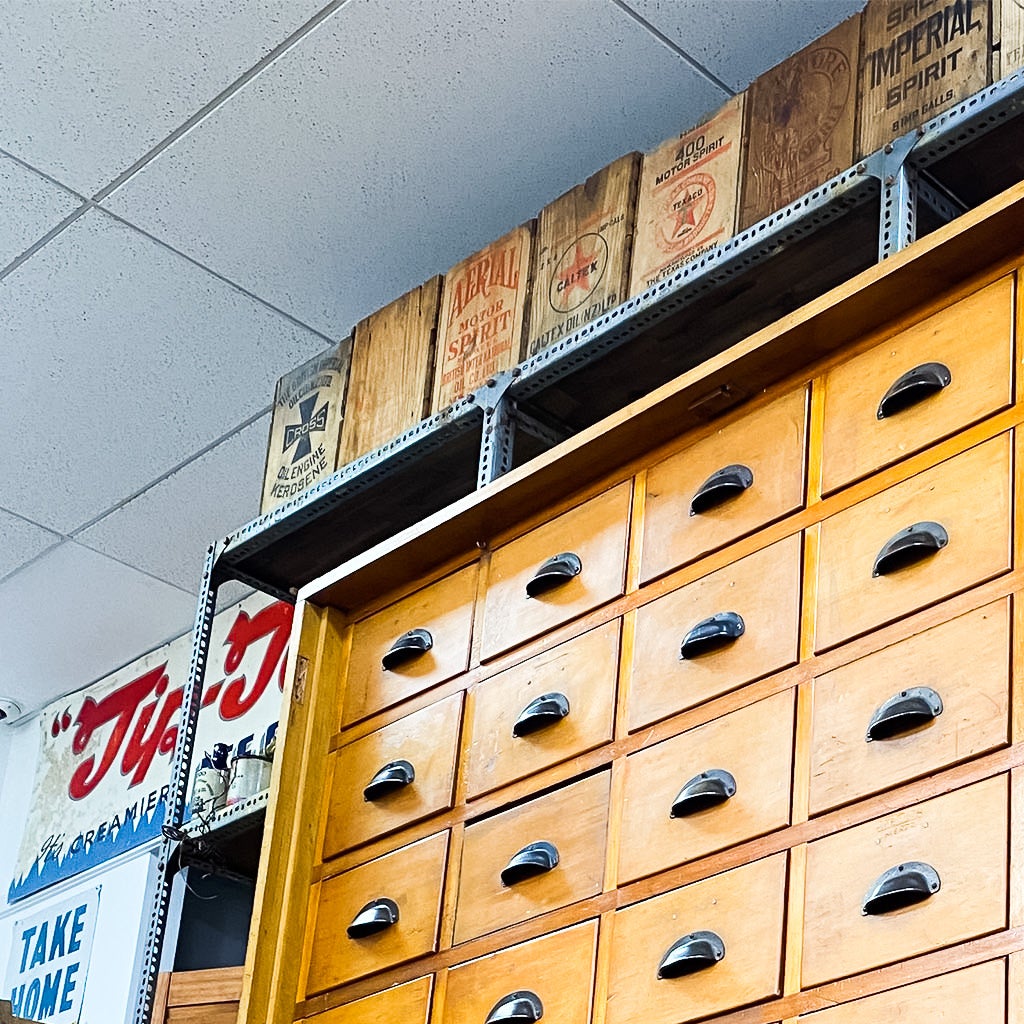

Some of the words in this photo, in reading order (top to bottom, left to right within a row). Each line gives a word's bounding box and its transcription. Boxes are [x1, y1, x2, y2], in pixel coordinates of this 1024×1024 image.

[866, 0, 982, 90] IMPERIAL
[887, 47, 962, 110] SPIRIT
[656, 158, 690, 185] MOTOR
[693, 136, 724, 162] SPIRIT
[675, 135, 705, 161] 400
[673, 188, 703, 211] TEXACO
[448, 246, 519, 328] AERIAL
[556, 260, 598, 293] CALTEX
[646, 275, 660, 287] THE
[662, 259, 684, 278] TEXAS
[686, 240, 719, 264] COMPANY
[448, 310, 511, 362] SPIRIT
[459, 299, 504, 334] MOTOR
[286, 408, 325, 448] CROSS
[270, 456, 328, 498] KEROSENE
[291, 443, 326, 480] ENGINE
[70, 784, 170, 855] CREAMIER
[20, 903, 88, 974] TAKE
[11, 961, 80, 1021] HOME
